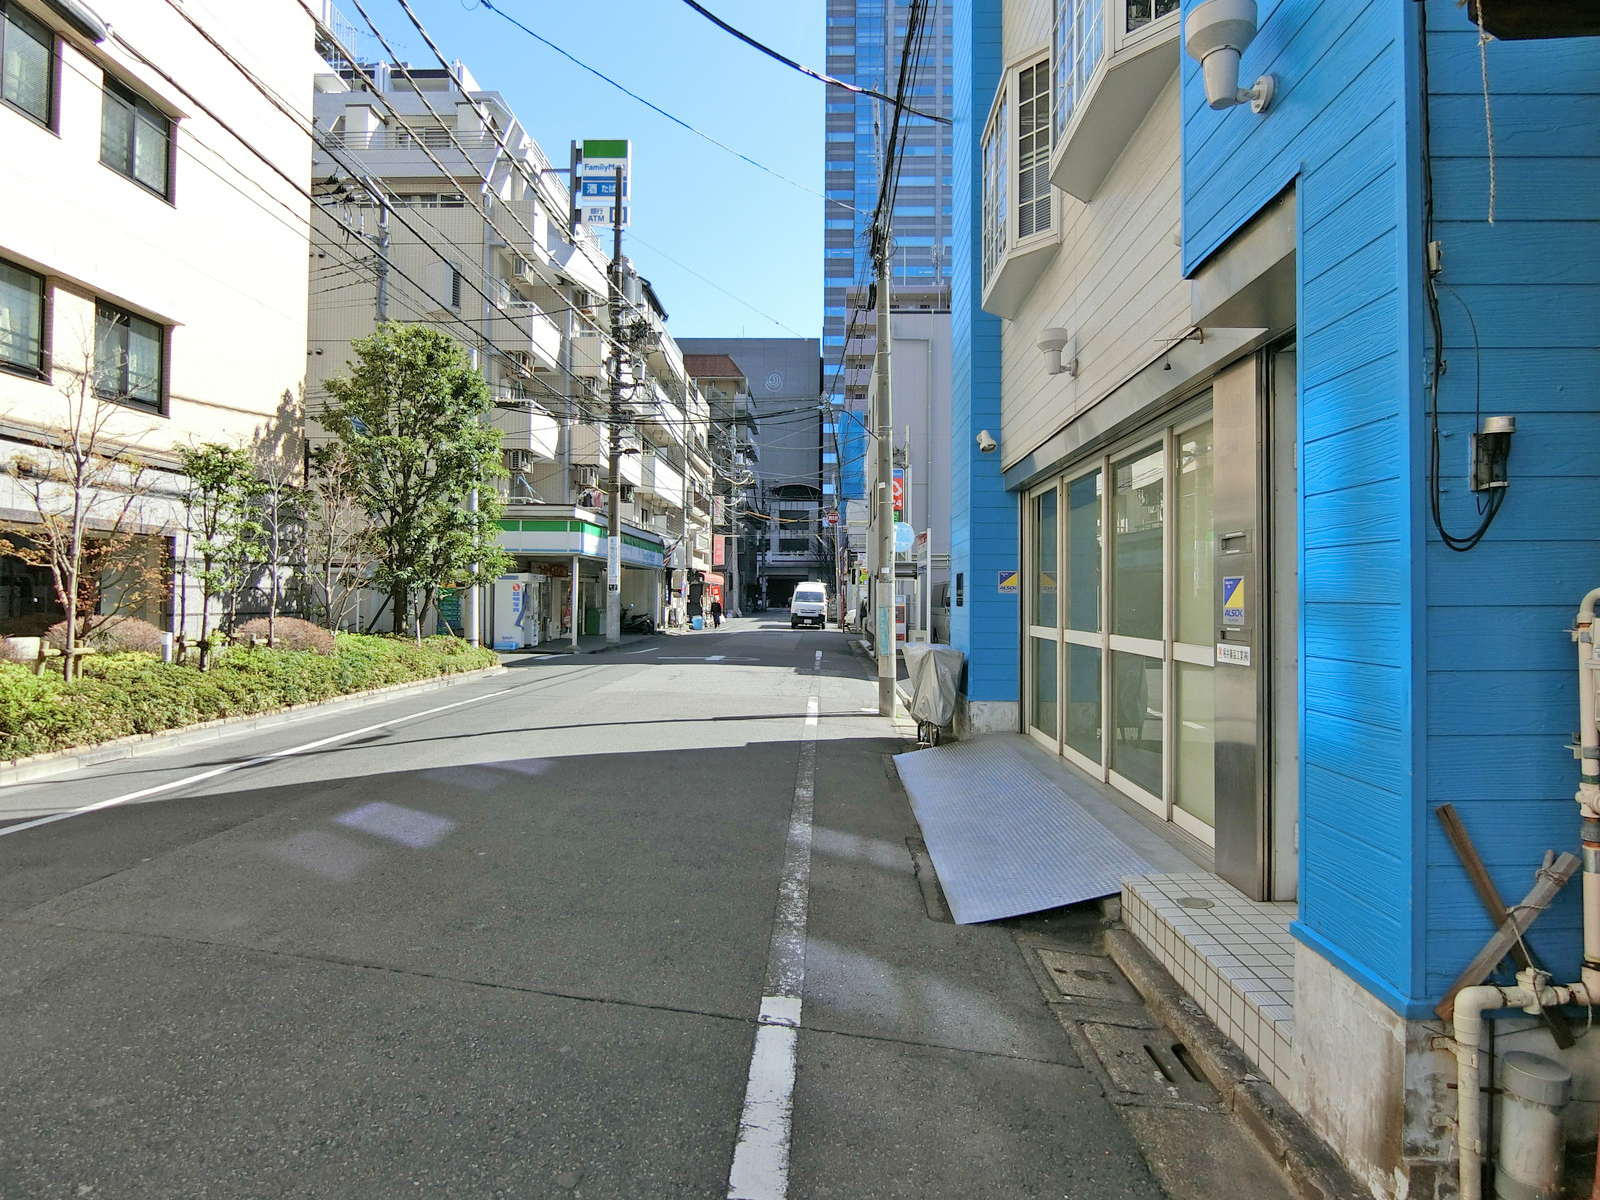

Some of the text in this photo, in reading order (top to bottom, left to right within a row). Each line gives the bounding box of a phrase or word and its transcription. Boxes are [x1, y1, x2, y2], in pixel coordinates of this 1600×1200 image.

[584, 163, 626, 172] FamilyMt
[587, 183, 598, 194] 酒
[590, 207, 603, 215] 銀行
[1224, 609, 1243, 618] ALSOK
